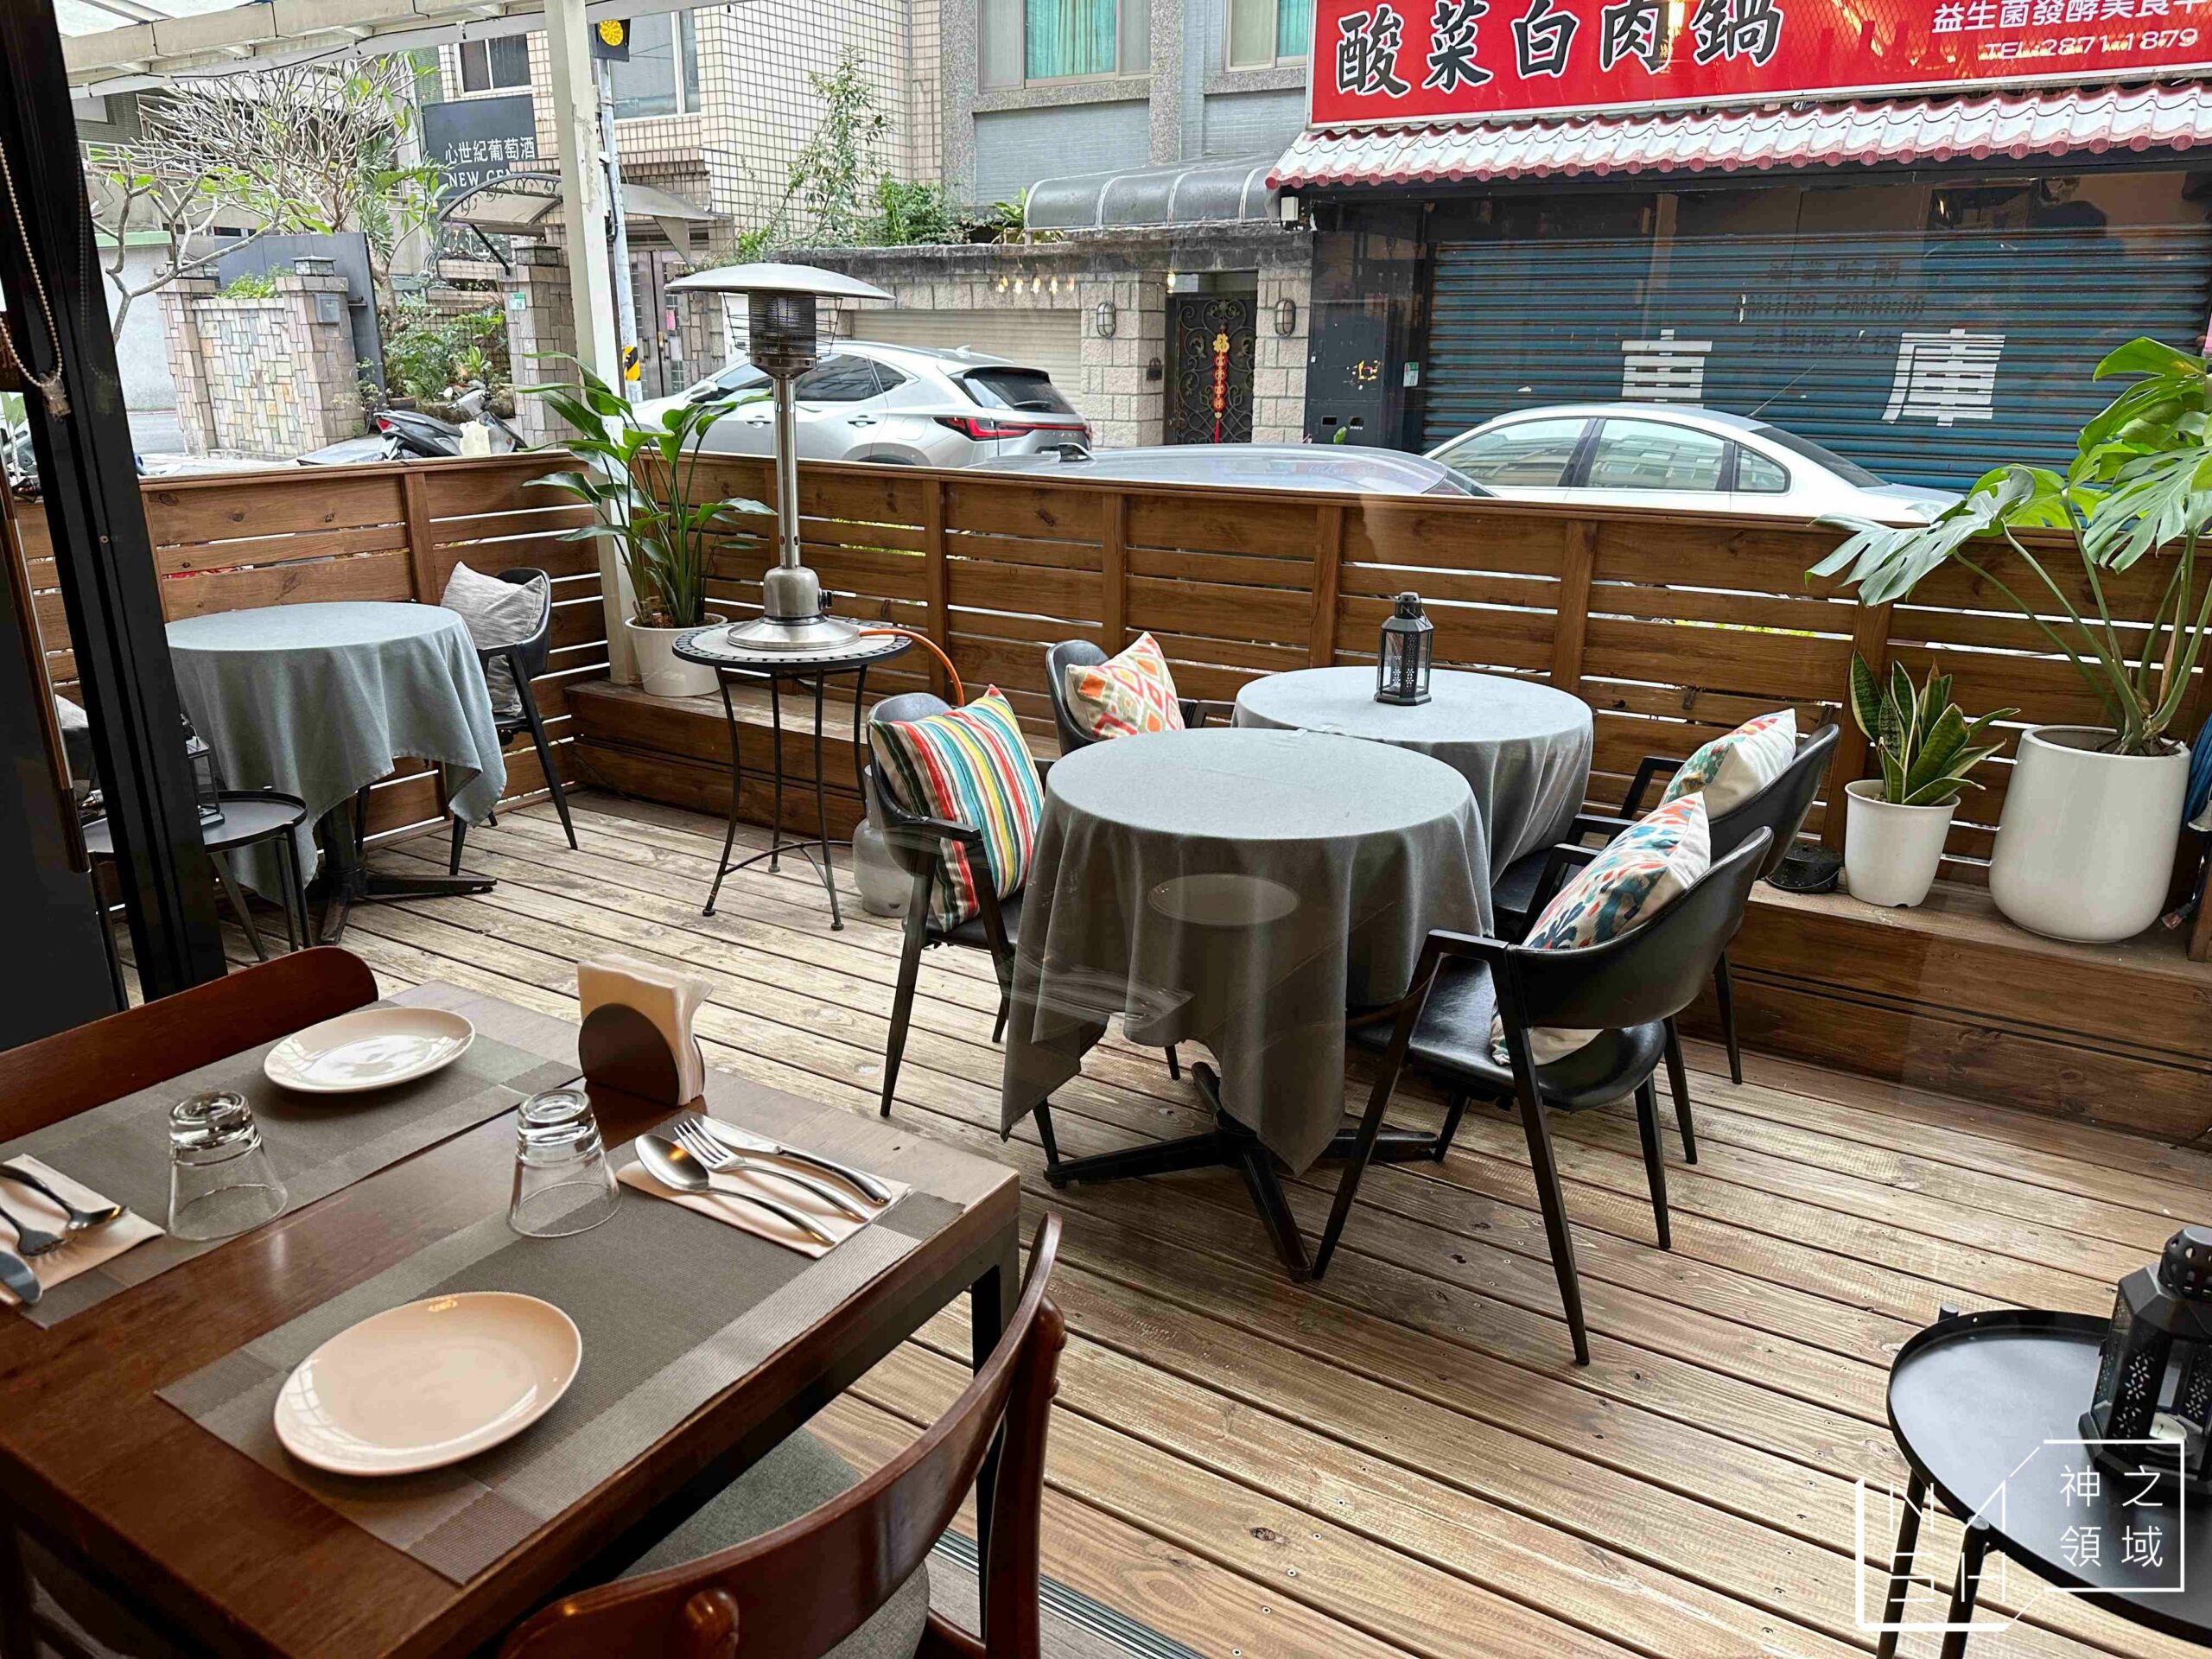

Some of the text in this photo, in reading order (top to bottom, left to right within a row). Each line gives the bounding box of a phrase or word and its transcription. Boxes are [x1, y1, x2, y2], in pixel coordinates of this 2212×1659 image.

[1336, 0, 1783, 99] 酸菜白肉鍋
[445, 137, 536, 164] 心世紀葡萄酒
[449, 170, 480, 188] NEW
